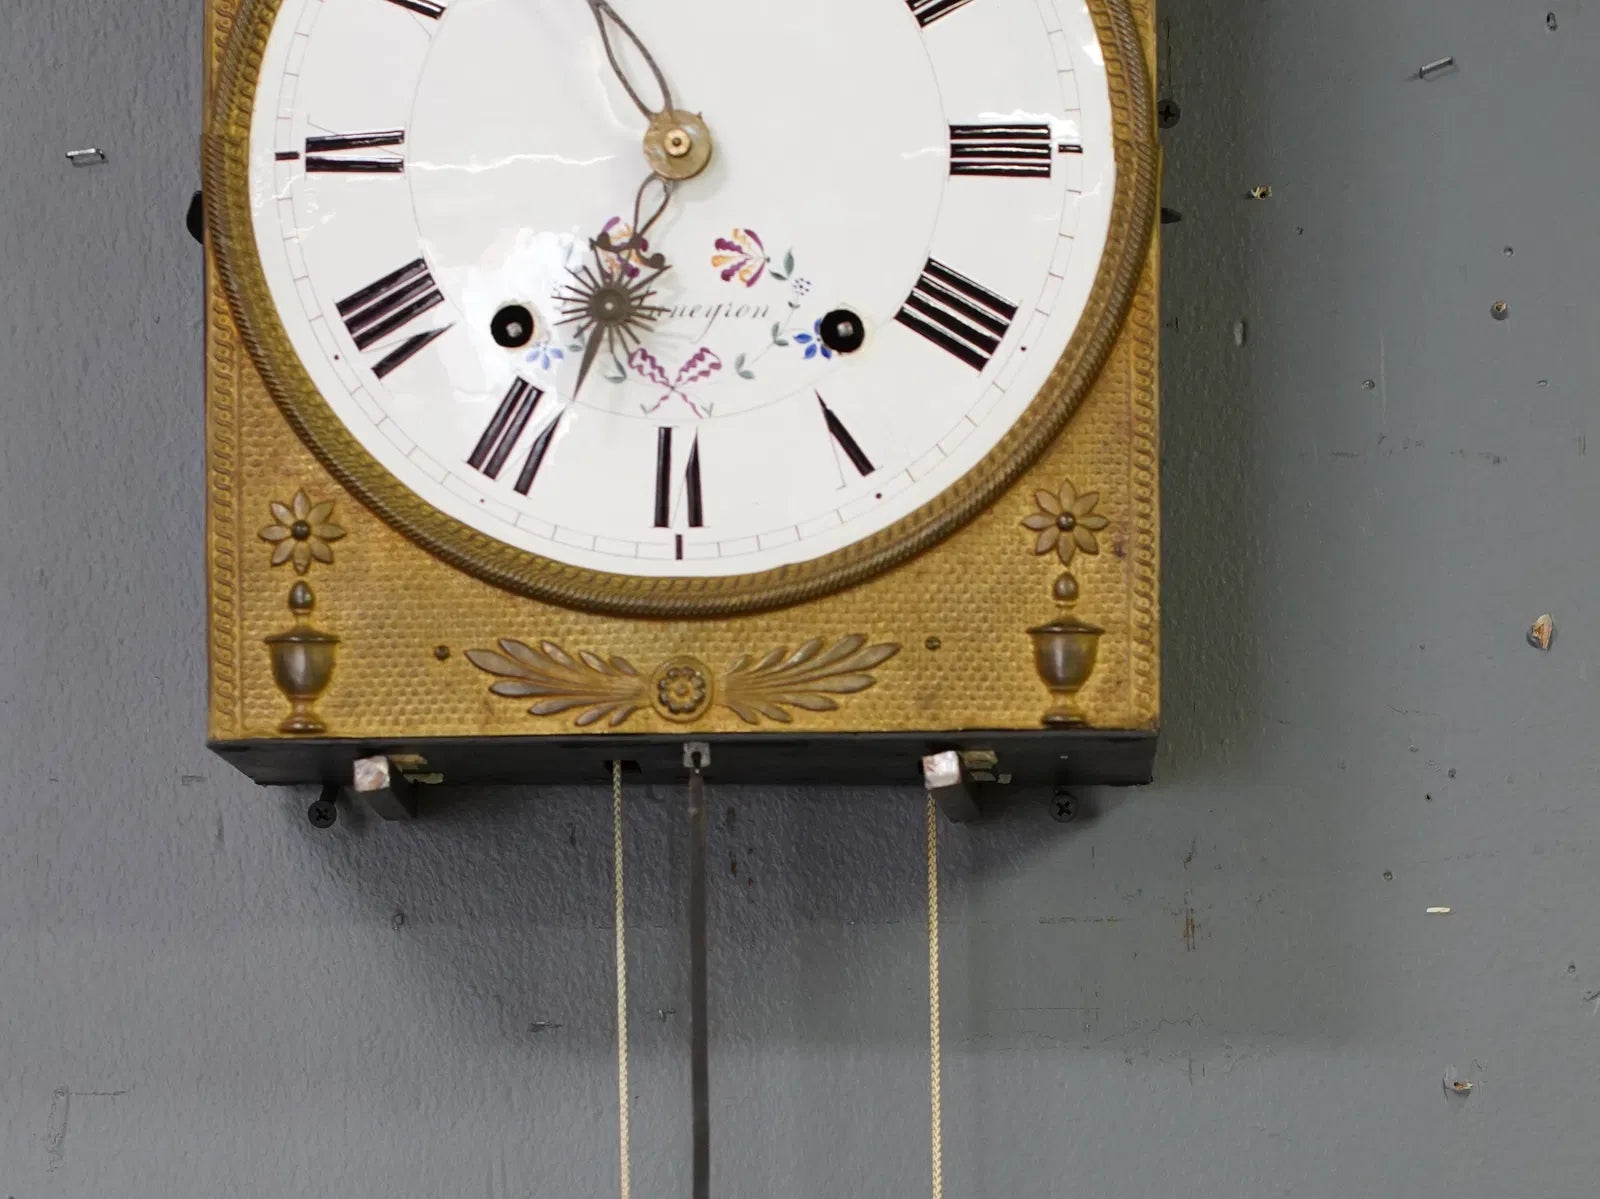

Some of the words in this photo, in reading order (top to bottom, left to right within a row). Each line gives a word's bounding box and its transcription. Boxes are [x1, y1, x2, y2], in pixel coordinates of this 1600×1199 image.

[948, 122, 1053, 179] III
[335, 255, 457, 380] VIII
[465, 374, 568, 498] VII
[652, 422, 706, 530] VI
[813, 388, 884, 490] V
